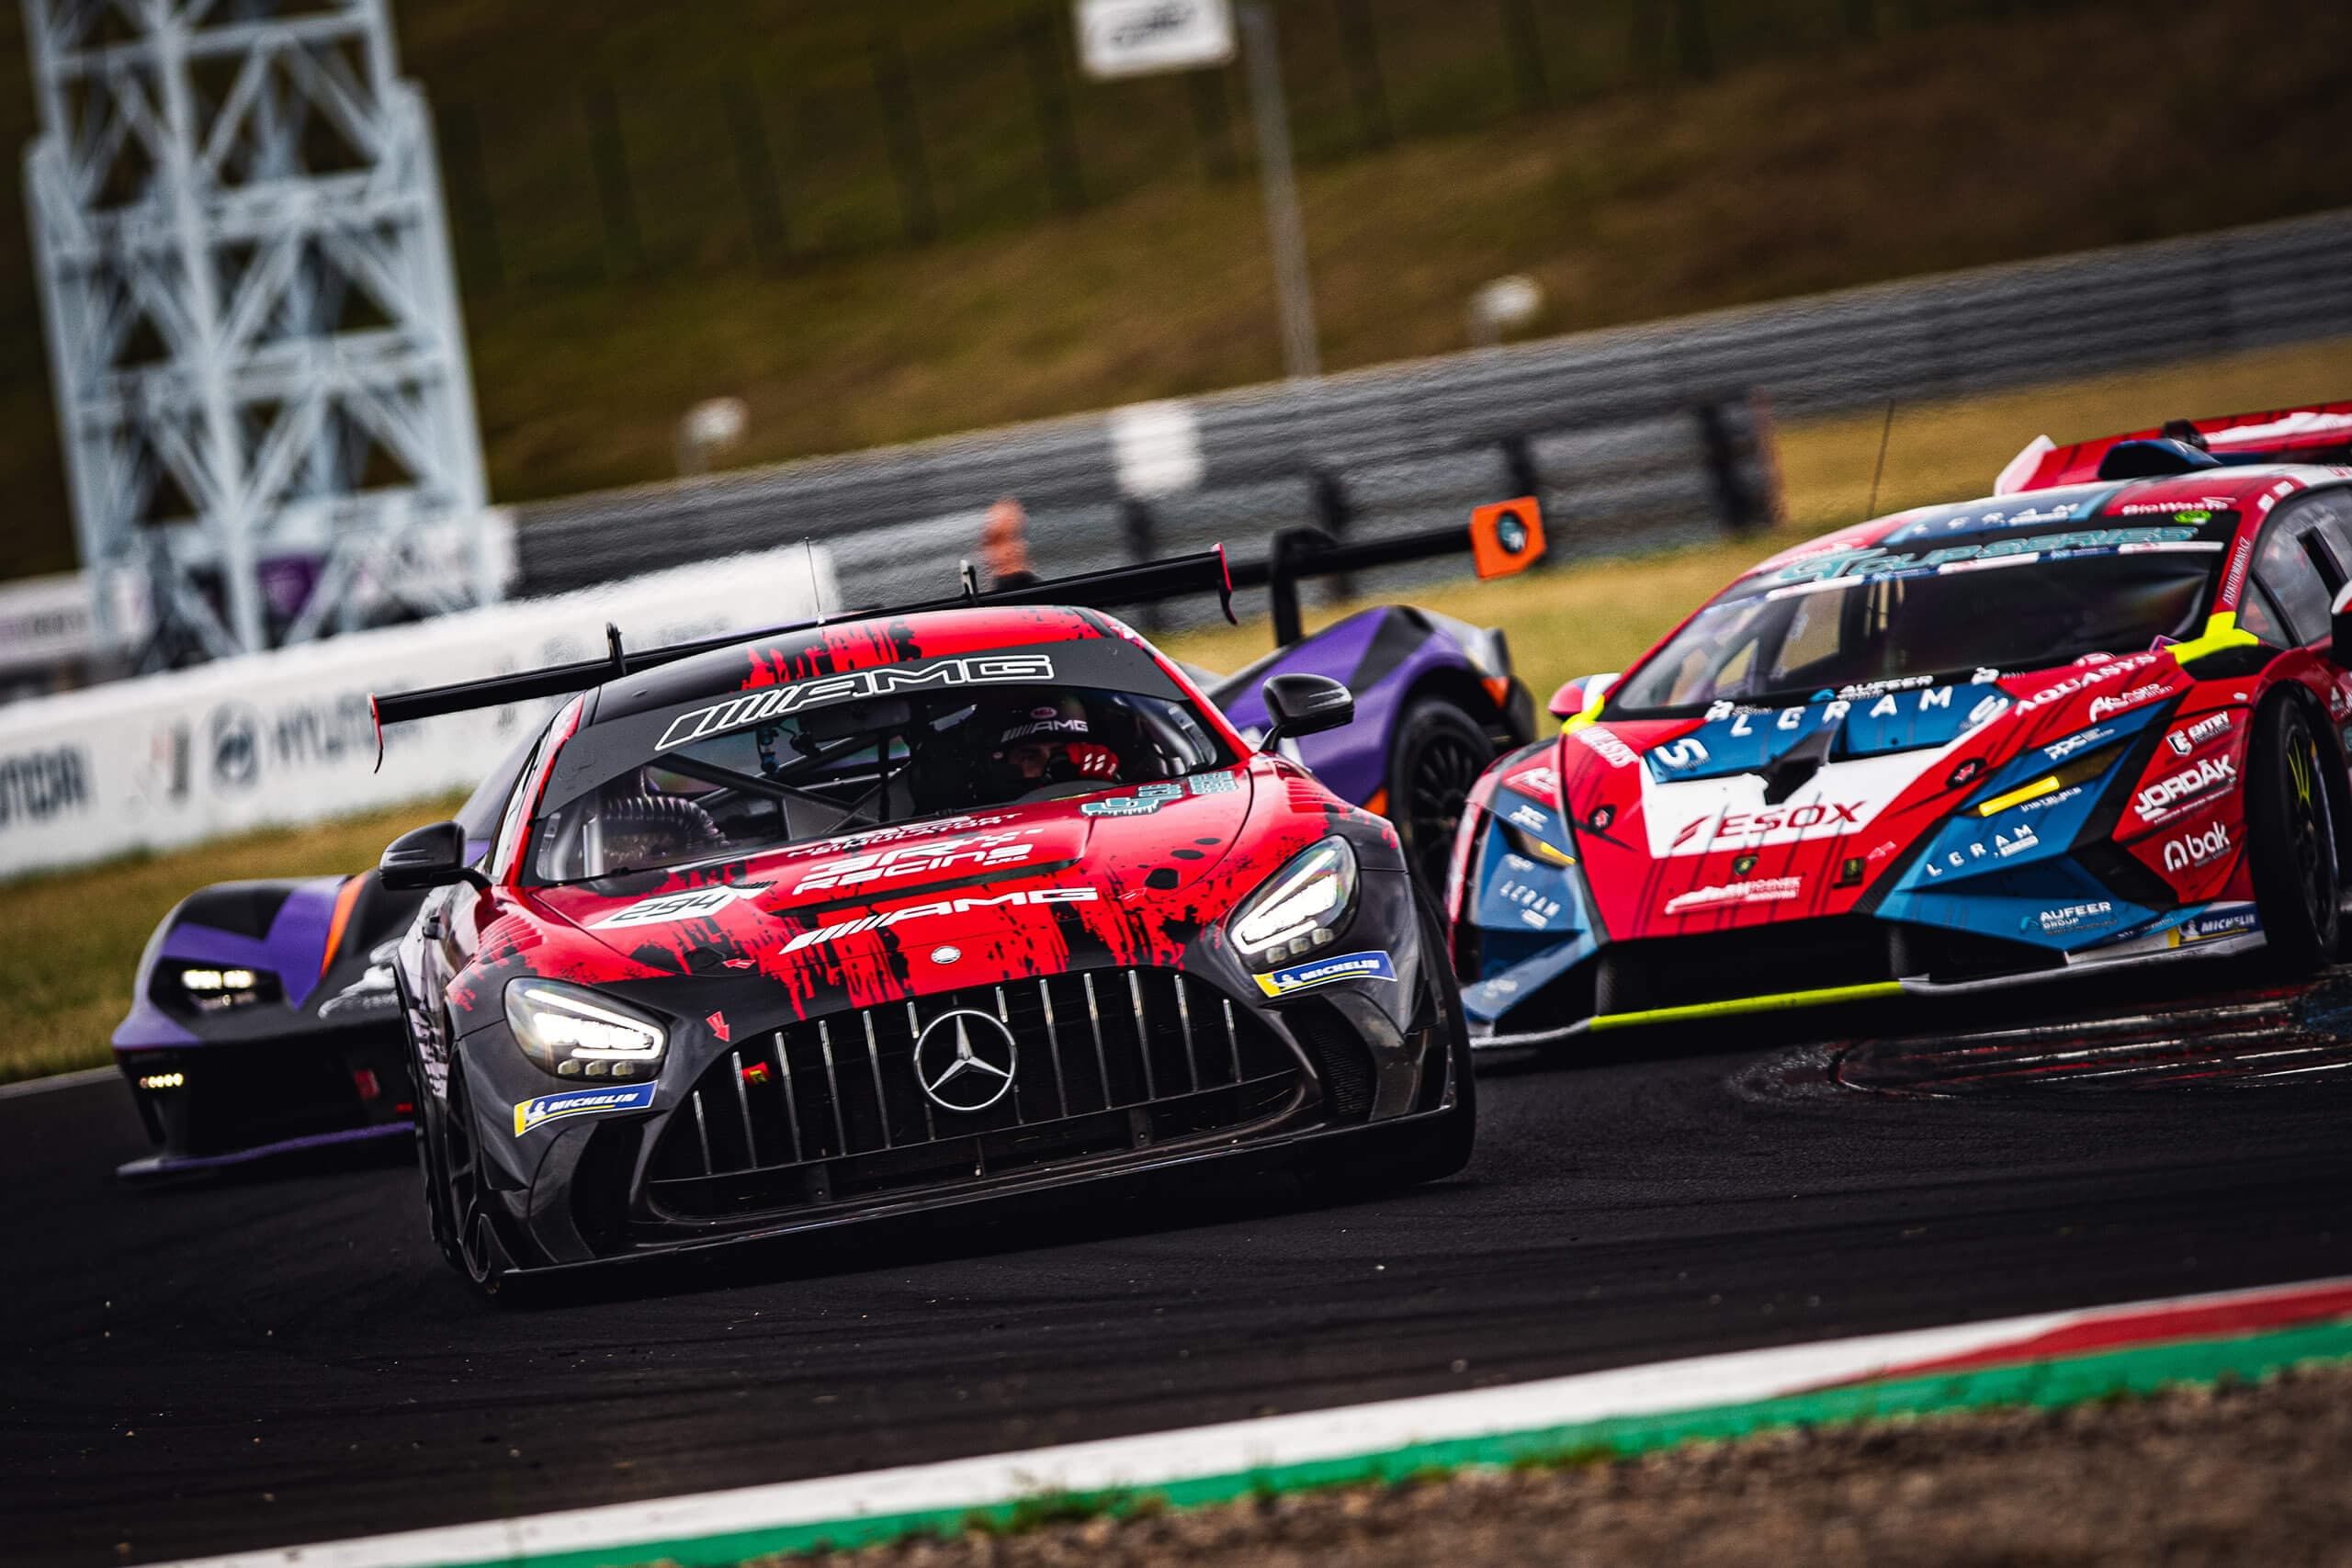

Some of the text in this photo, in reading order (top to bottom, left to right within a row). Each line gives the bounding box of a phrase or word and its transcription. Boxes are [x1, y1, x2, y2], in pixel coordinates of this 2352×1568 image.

[1715, 800, 1866, 840] ESOX
[2185, 821, 2231, 860] bak
[611, 894, 728, 921] 294
[2040, 901, 2111, 922] AUFEER
[1300, 960, 1380, 981] MICHELIN
[548, 1093, 639, 1112] MICHELIN
